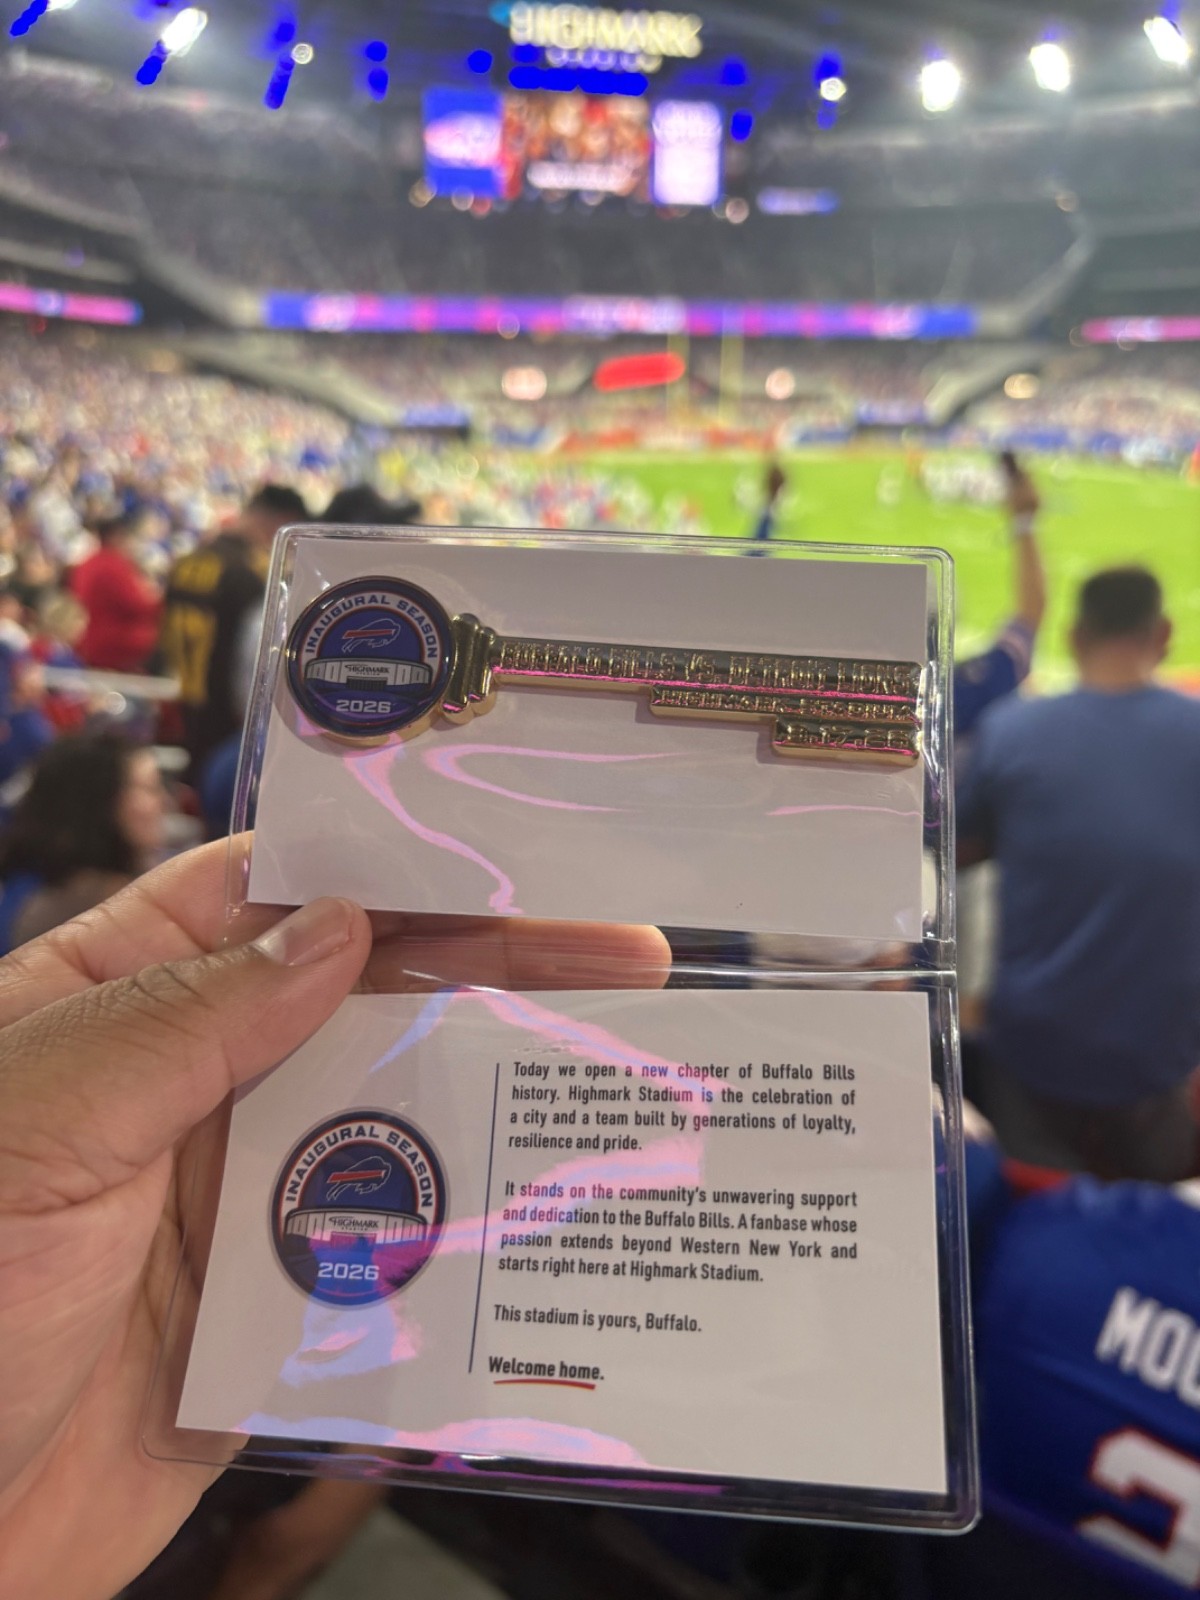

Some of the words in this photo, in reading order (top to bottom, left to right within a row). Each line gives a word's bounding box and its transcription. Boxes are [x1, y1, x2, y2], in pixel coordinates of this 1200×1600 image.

[305, 594, 391, 654] INAUGURAL
[397, 599, 438, 658] SEASON
[345, 664, 390, 674] HIGHMARK
[336, 699, 391, 714] 2026
[514, 1062, 549, 1080] Today
[558, 1066, 575, 1077] we
[585, 1065, 616, 1080] open
[625, 1066, 632, 1077] a
[642, 1066, 668, 1077] new
[678, 1063, 729, 1082] chapter
[738, 1064, 752, 1080] of
[762, 1064, 813, 1080] Buffalo
[823, 1064, 854, 1081] Bills
[512, 1086, 560, 1103] history.
[569, 1087, 630, 1104] Highmark
[639, 1087, 692, 1103] Stadium
[702, 1088, 712, 1103] is
[722, 1088, 742, 1103] the
[752, 1089, 832, 1105] celebration
[842, 1090, 855, 1105] of
[510, 1112, 517, 1125] a
[523, 1110, 547, 1128] city
[553, 1110, 576, 1125] and
[582, 1114, 589, 1126] a
[596, 1111, 628, 1126] team
[635, 1111, 665, 1126] built
[671, 1112, 687, 1130] by
[693, 1113, 775, 1131] generations
[783, 1114, 796, 1129] of
[803, 1114, 856, 1134] loyalty,
[509, 1133, 572, 1149] resilience
[576, 1135, 599, 1150] and
[603, 1135, 642, 1153] pride.
[286, 1125, 380, 1201] INAUGURAL
[386, 1130, 433, 1207] SEASON
[505, 1181, 514, 1196] It
[521, 1183, 563, 1198] stands
[570, 1186, 586, 1199] on
[592, 1185, 613, 1200] the
[620, 1186, 706, 1203] community's
[713, 1190, 794, 1209] unwavering
[801, 1191, 857, 1210] support
[329, 1216, 379, 1228] HIGHMARK
[503, 1208, 525, 1222] and
[530, 1208, 599, 1224] dedication
[603, 1210, 616, 1225] to
[620, 1210, 641, 1225] the
[645, 1211, 695, 1227] Buffalo
[699, 1212, 735, 1229] Bills.
[738, 1213, 747, 1229] A
[751, 1214, 807, 1231] fanbase
[811, 1216, 857, 1232] whose
[501, 1232, 552, 1249] passion
[561, 1234, 613, 1250] extends
[622, 1236, 671, 1254] beyond
[681, 1237, 740, 1254] Western
[750, 1239, 780, 1256] New
[790, 1240, 821, 1257] York
[831, 1242, 857, 1259] and
[318, 1262, 380, 1280] 2026
[498, 1257, 538, 1271] starts
[542, 1257, 574, 1277] right
[579, 1259, 609, 1275] here
[612, 1263, 626, 1276] at
[630, 1261, 697, 1280] Highmark
[701, 1264, 763, 1282] Stadium.
[494, 1304, 521, 1322] This
[525, 1307, 579, 1325] stadium
[583, 1311, 594, 1326] is
[598, 1315, 641, 1332] yours,
[646, 1312, 702, 1332] Buffalo.
[489, 1356, 555, 1377] Welcome
[560, 1361, 604, 1380] home.
